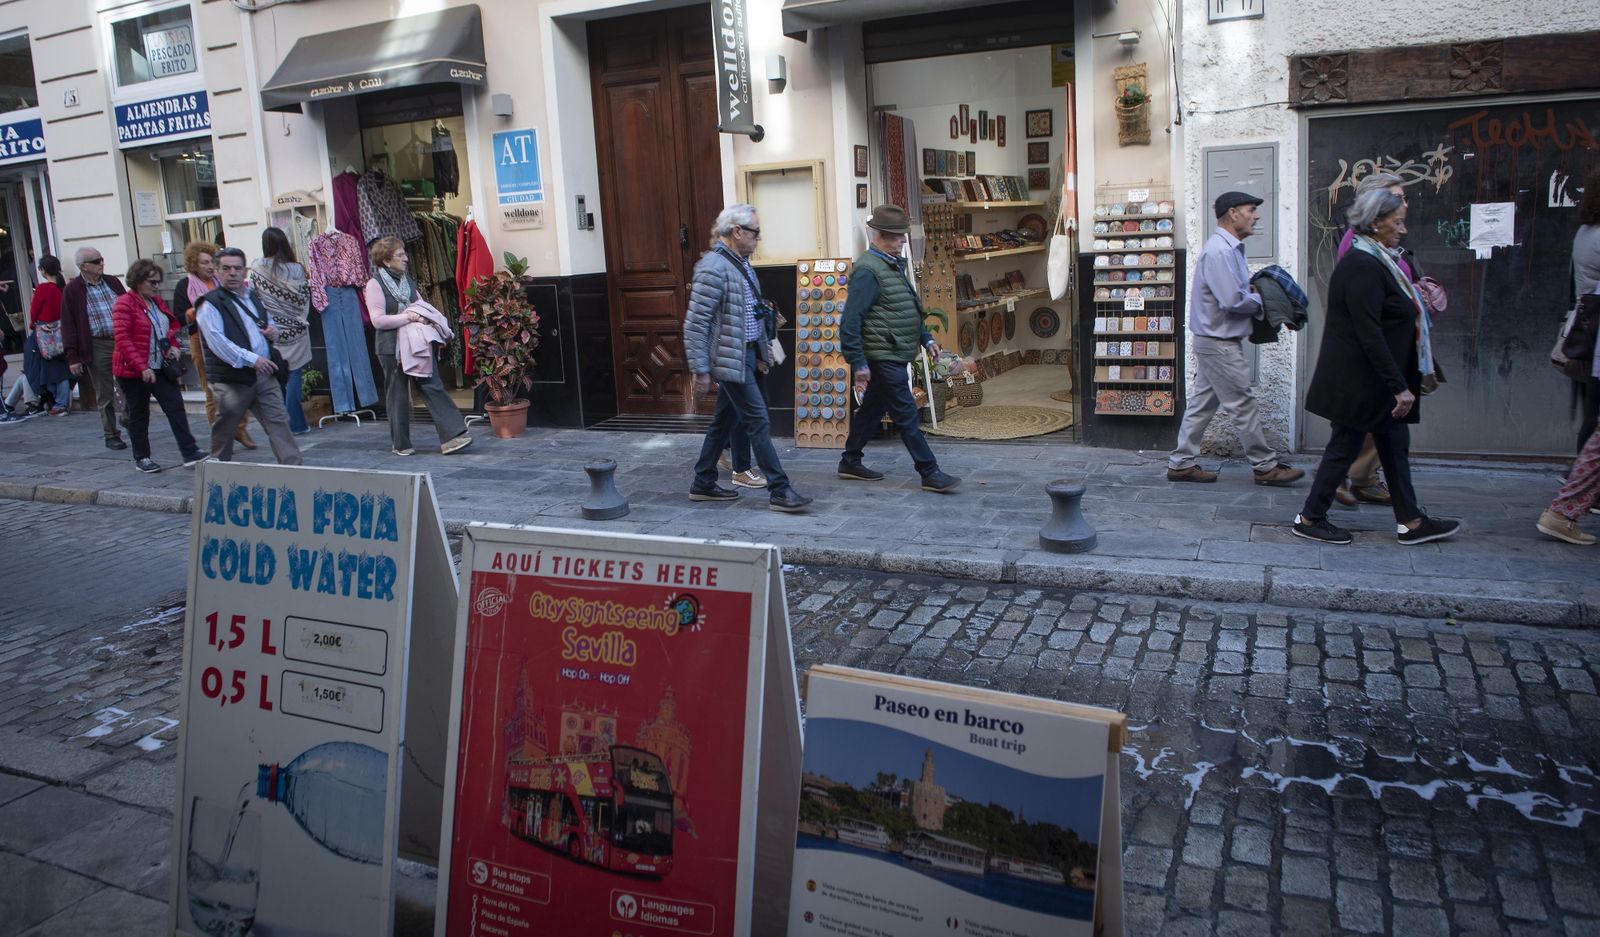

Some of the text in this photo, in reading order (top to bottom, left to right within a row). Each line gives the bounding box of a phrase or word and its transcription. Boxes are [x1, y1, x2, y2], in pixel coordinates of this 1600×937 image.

[151, 43, 191, 61] PESCADO
[161, 58, 187, 74] FRITO
[735, 30, 748, 104] cathedral
[347, 81, 355, 92] &
[126, 95, 198, 121] ALMENDRAS
[118, 111, 212, 140] PATATAS FRITAS
[500, 135, 532, 166] AT
[506, 194, 535, 203] CIUDAD
[504, 208, 540, 218] welldone
[204, 483, 398, 542] AGUA FRIA
[201, 538, 397, 601] COLD WATER
[491, 550, 719, 587] AQUÍ TICKETS HERE
[529, 590, 680, 636] City Sightseeing
[205, 611, 342, 656] 1,5 L 2,00€
[561, 626, 637, 667] Sevilla
[201, 666, 342, 712] 0,5 L 1,50€
[562, 668, 577, 679] Hop
[578, 668, 590, 680] On
[599, 672, 616, 684] Hop
[617, 674, 631, 685] Off
[873, 694, 1024, 735] Paseo en barco
[969, 732, 1026, 755] Boat trip
[491, 879, 525, 895] Paradas
[492, 866, 531, 885] Bus stops
[640, 911, 679, 926] Idiomas
[641, 897, 695, 916] Languages
